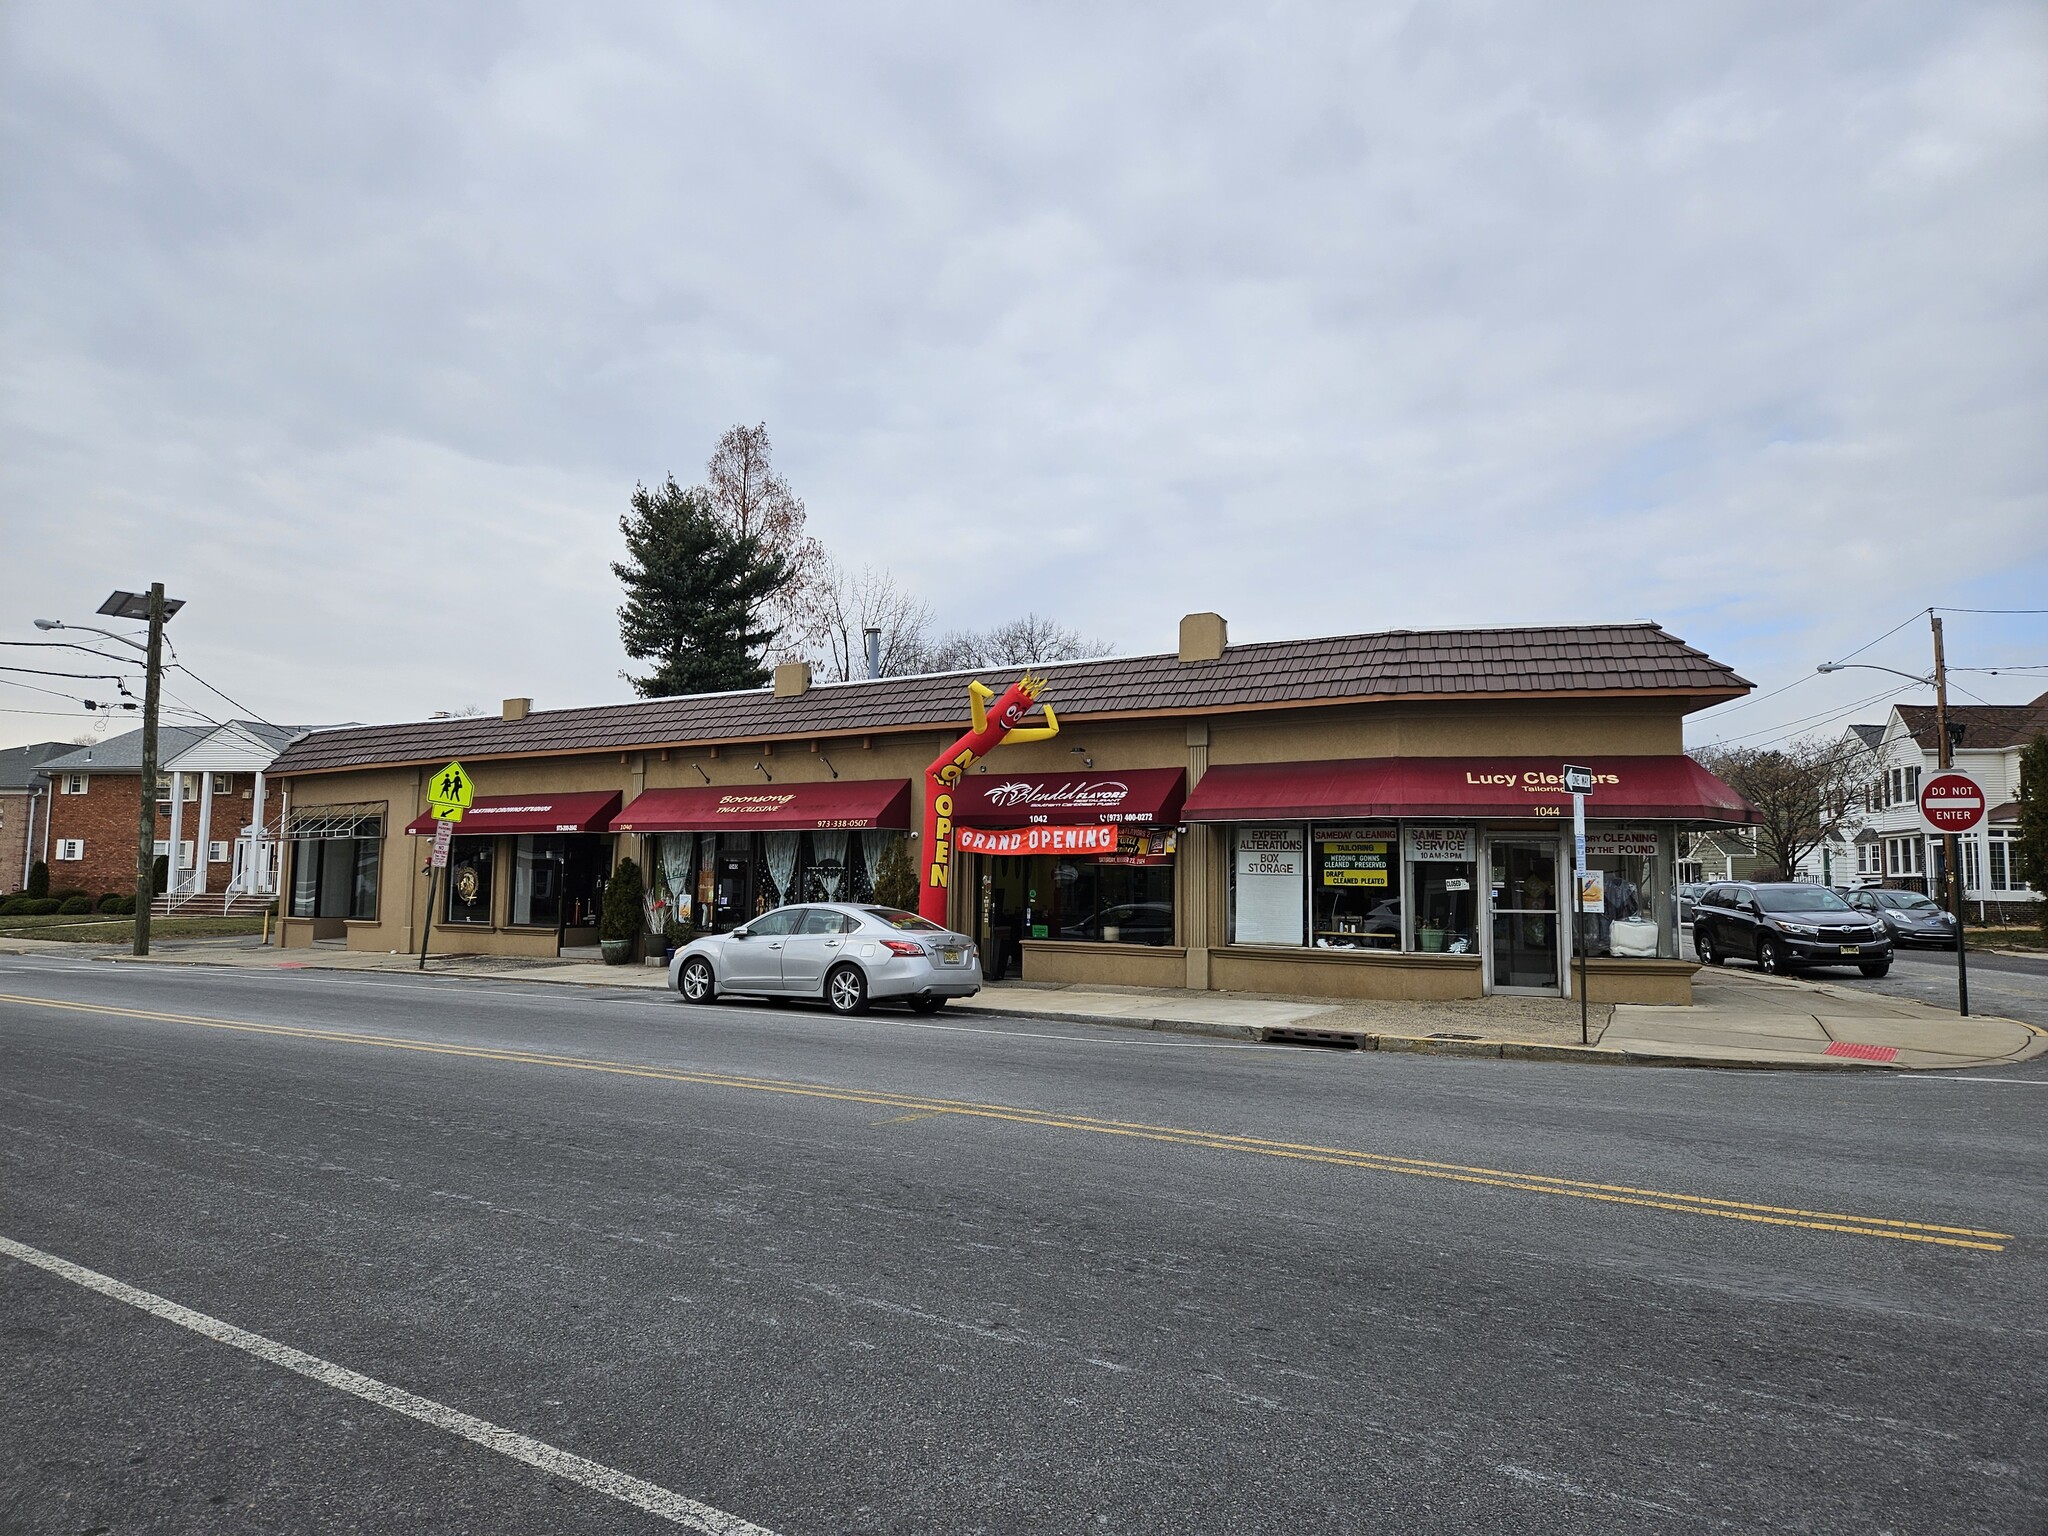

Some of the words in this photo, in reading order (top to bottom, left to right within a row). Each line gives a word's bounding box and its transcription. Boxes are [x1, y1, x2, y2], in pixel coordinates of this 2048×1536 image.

[1466, 772, 1516, 787] Lucy
[1572, 774, 1580, 785] ONE
[1581, 775, 1590, 786] WAY
[1007, 782, 1086, 806] Blended
[1076, 791, 1128, 799] FLAVORS
[1931, 787, 1946, 796] DO
[1952, 786, 1973, 795] NOT
[719, 793, 796, 805] Boonsong
[715, 806, 740, 814] THAI
[740, 805, 780, 813] CUISINE
[1534, 807, 1560, 816] 1044
[1029, 815, 1048, 823] 1042
[1106, 813, 1123, 822] (973)
[1124, 813, 1153, 822] 400-0272
[1936, 811, 1971, 820] ENTER
[817, 819, 868, 828] 973-338-0507
[961, 831, 1021, 850] GRAND
[1028, 828, 1110, 849] OPENING
[1252, 830, 1288, 840] EXPERT
[1315, 831, 1353, 839] SAMEDAY
[1355, 830, 1396, 839] CLEANING
[1412, 830, 1442, 840] SAME
[1447, 830, 1467, 840] DAY
[1603, 833, 1657, 842] CLEANING
[930, 794, 953, 888] OPEN
[1240, 840, 1303, 850] ALTERATIONS
[1415, 840, 1465, 851] SERVICE
[1337, 844, 1375, 852] TAILORING
[1618, 845, 1655, 854] POUND
[1260, 853, 1279, 863] BOX
[1248, 863, 1293, 874] STORAGE
